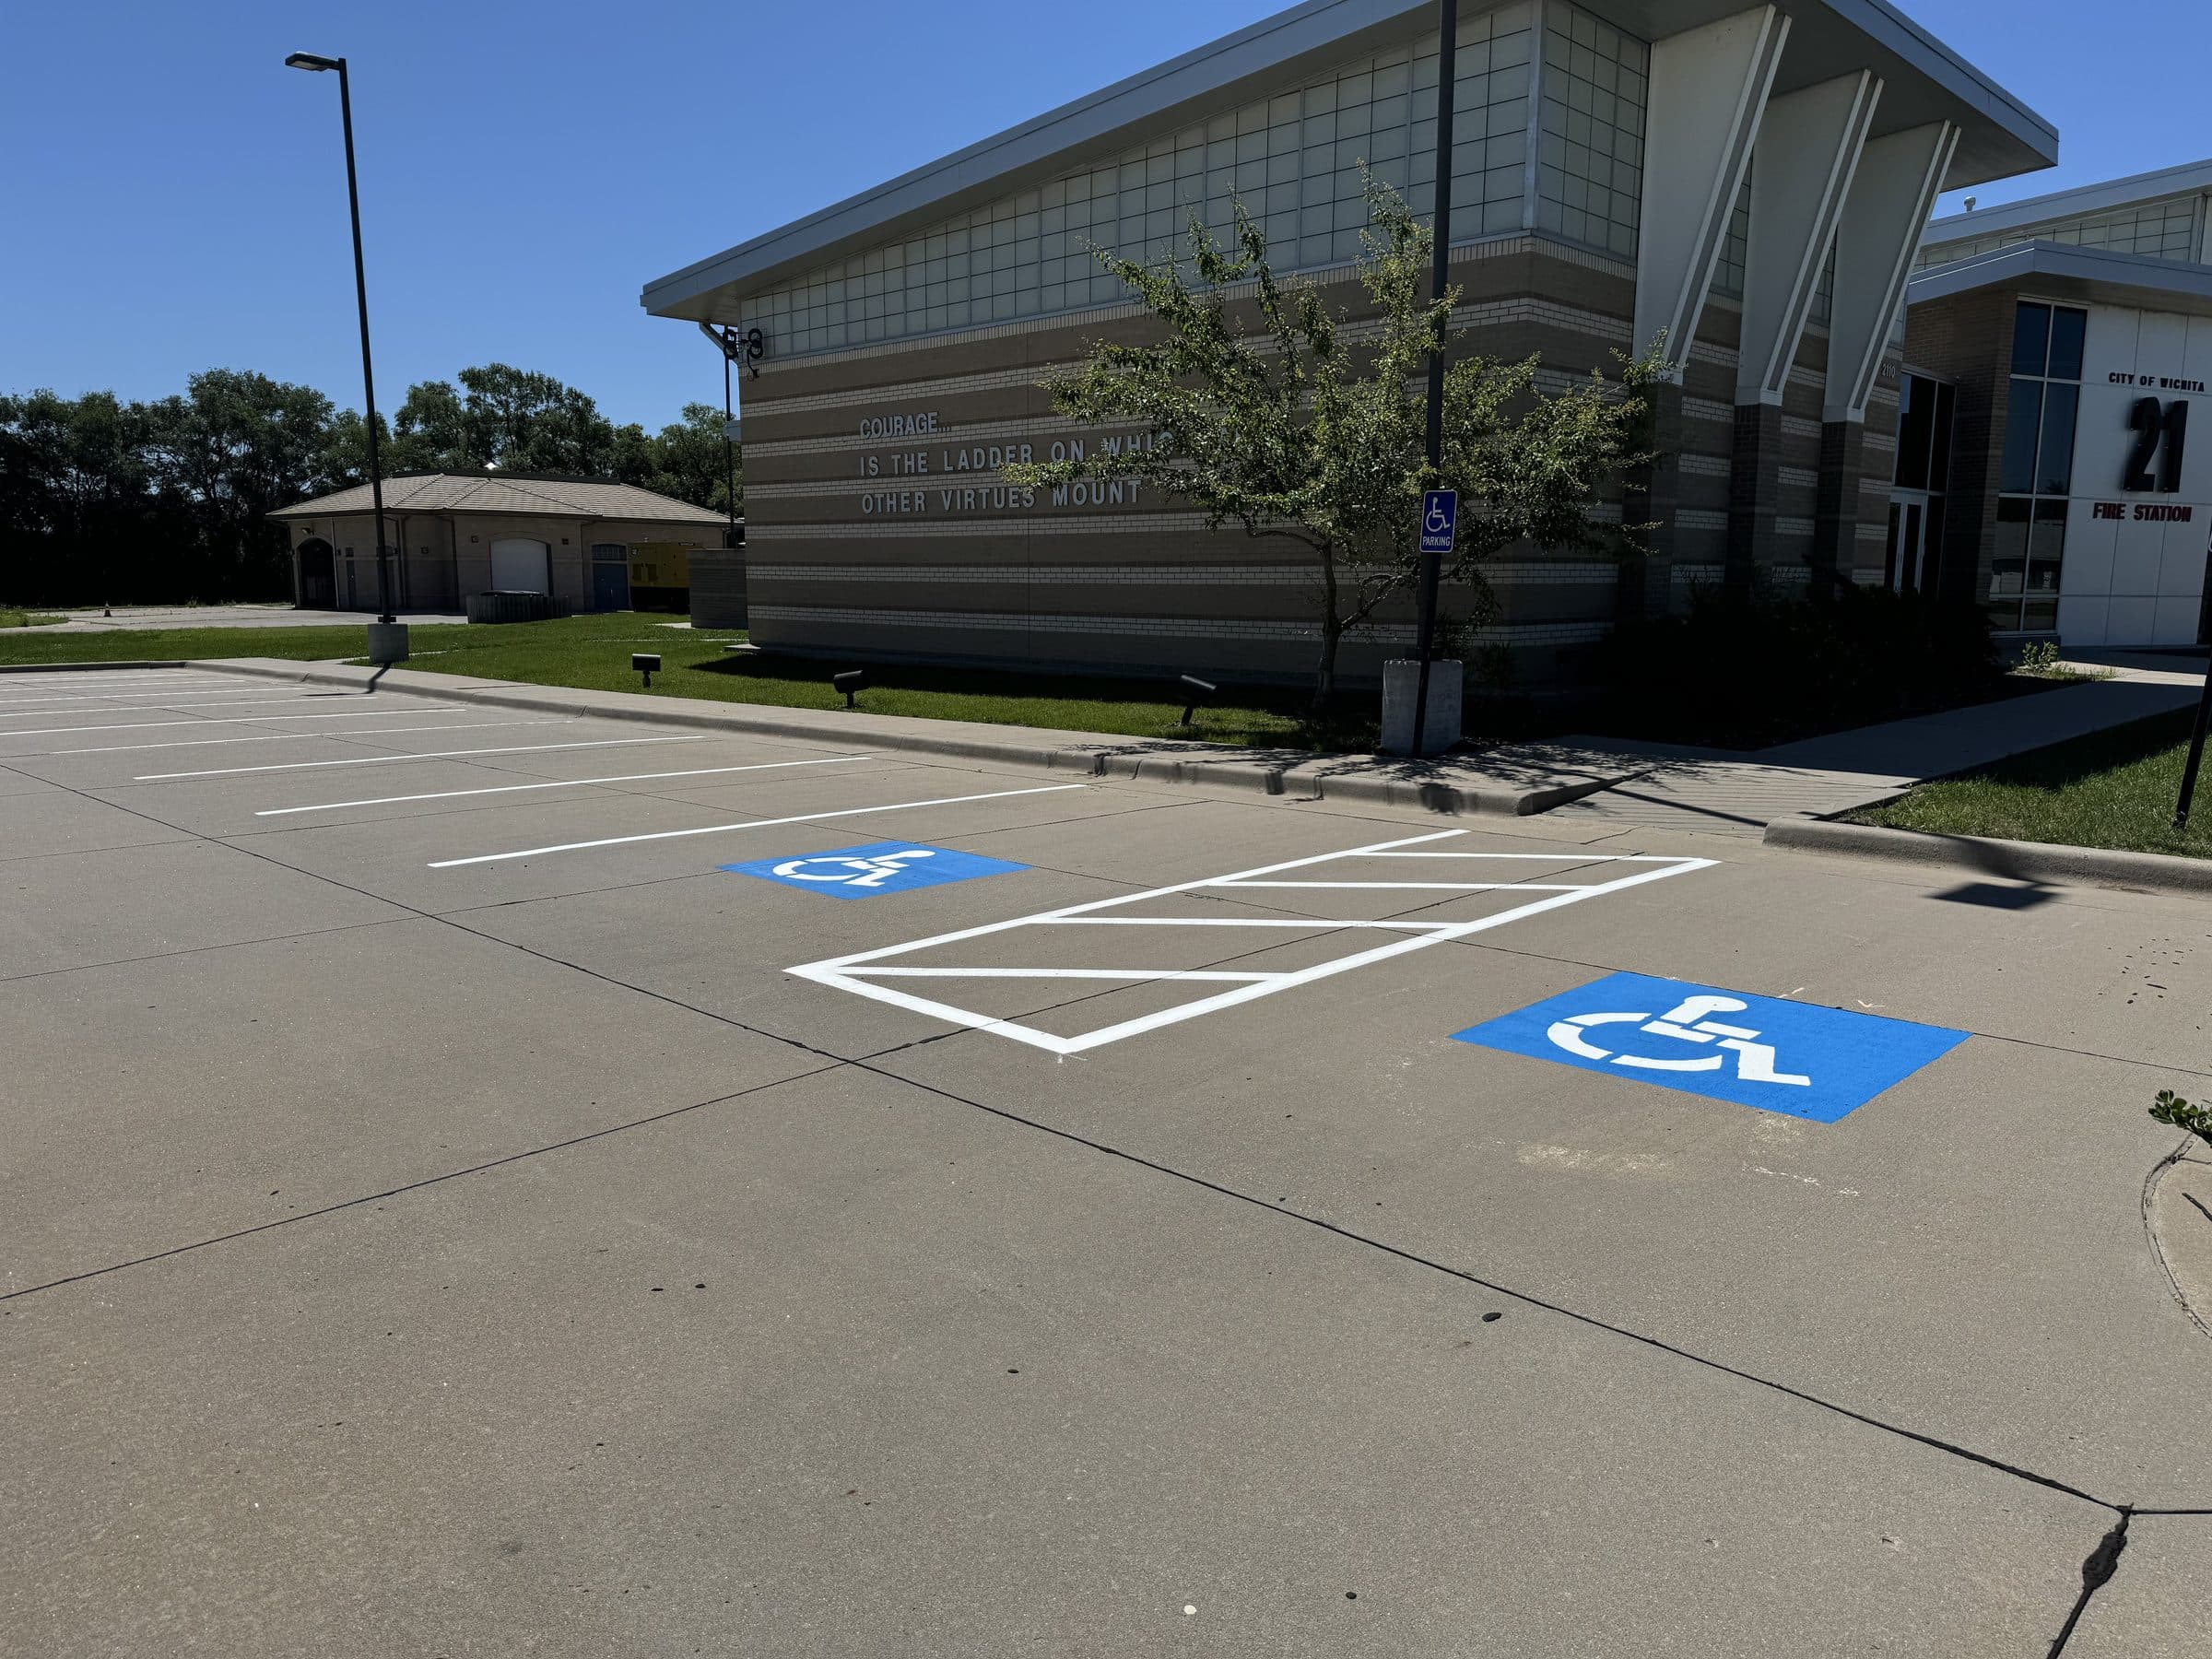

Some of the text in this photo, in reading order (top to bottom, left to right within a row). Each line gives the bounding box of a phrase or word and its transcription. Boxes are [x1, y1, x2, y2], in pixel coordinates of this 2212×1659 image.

[2109, 371, 2205, 393] CITY OF WICHITA
[860, 455, 879, 477] IS
[891, 452, 928, 475] THE
[944, 444, 1033, 471] LADDER
[1051, 440, 1085, 462] ON
[2123, 396, 2189, 493] 21
[862, 480, 1142, 514] OTHER VIRTUES MOUNT
[2092, 502, 2193, 523] FIRE STATION
[1422, 535, 1451, 547] PARKING
